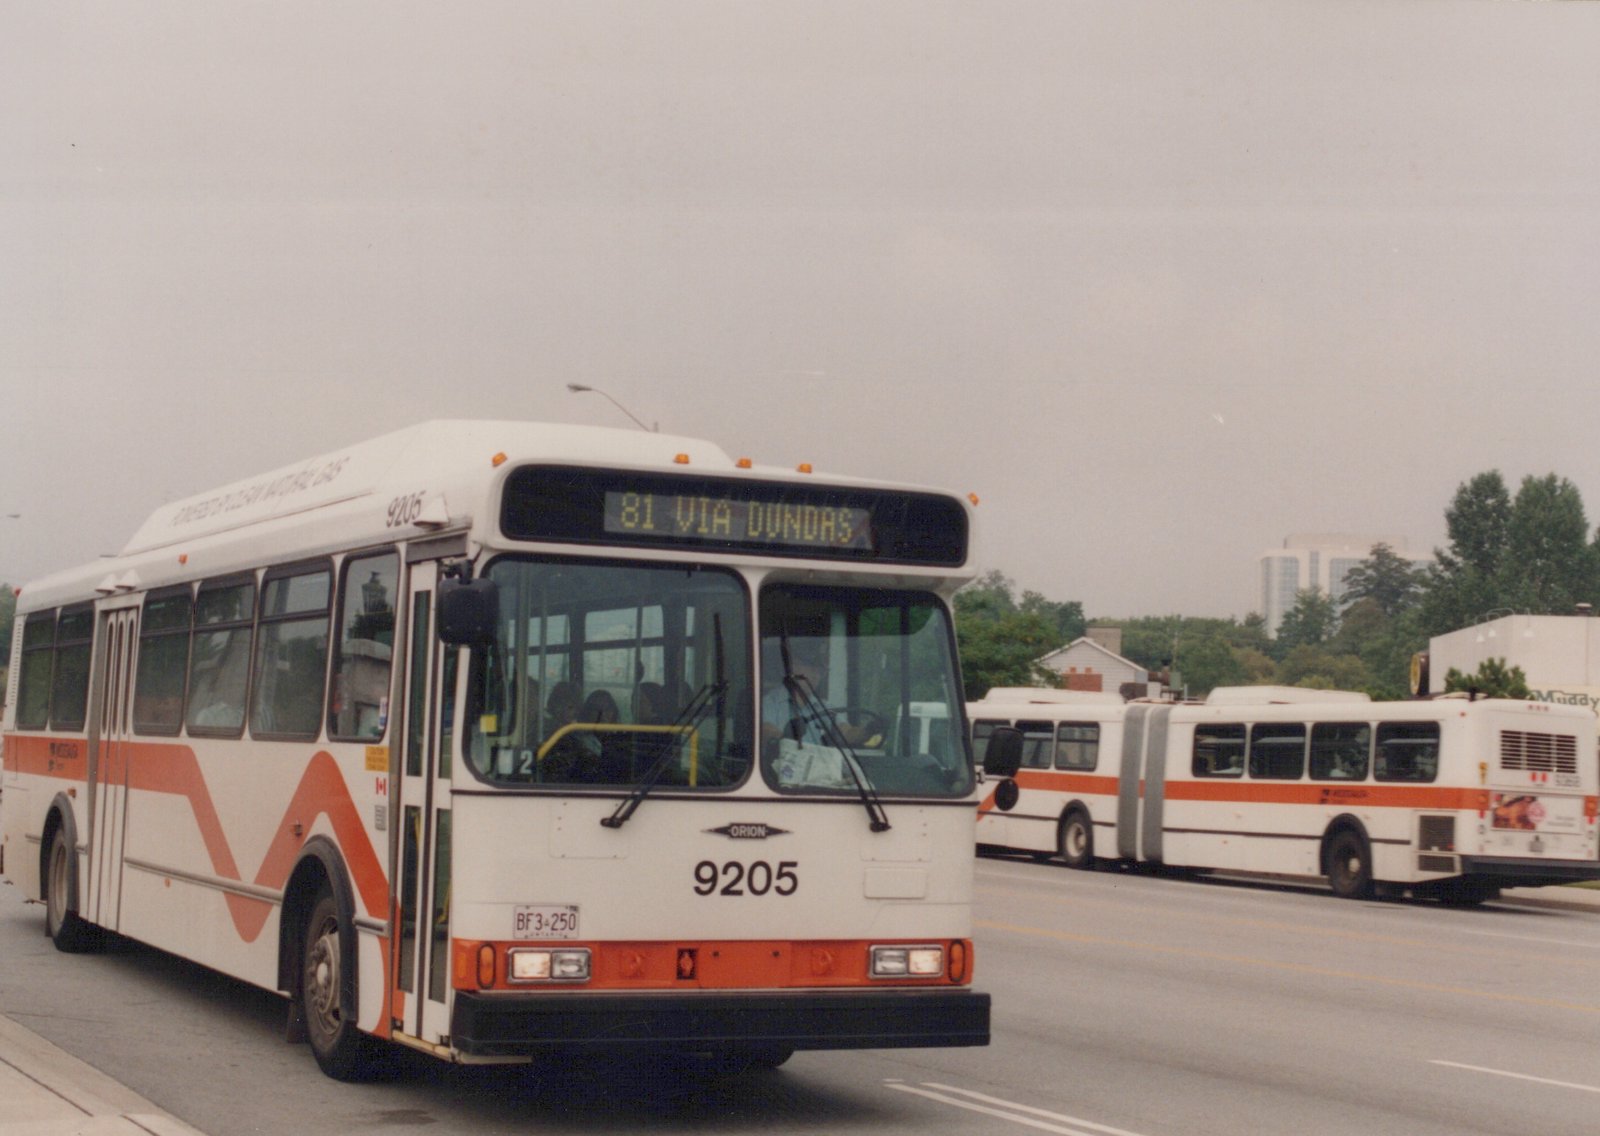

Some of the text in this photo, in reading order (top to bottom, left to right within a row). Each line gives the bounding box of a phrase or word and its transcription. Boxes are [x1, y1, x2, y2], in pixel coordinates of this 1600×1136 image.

[386, 489, 427, 528] 9205
[620, 492, 852, 543] 81 VIA DUNDAS
[1532, 689, 1600, 714] Muddy
[519, 750, 533, 775] 2
[730, 825, 766, 838] ORION
[693, 860, 799, 897] 9205
